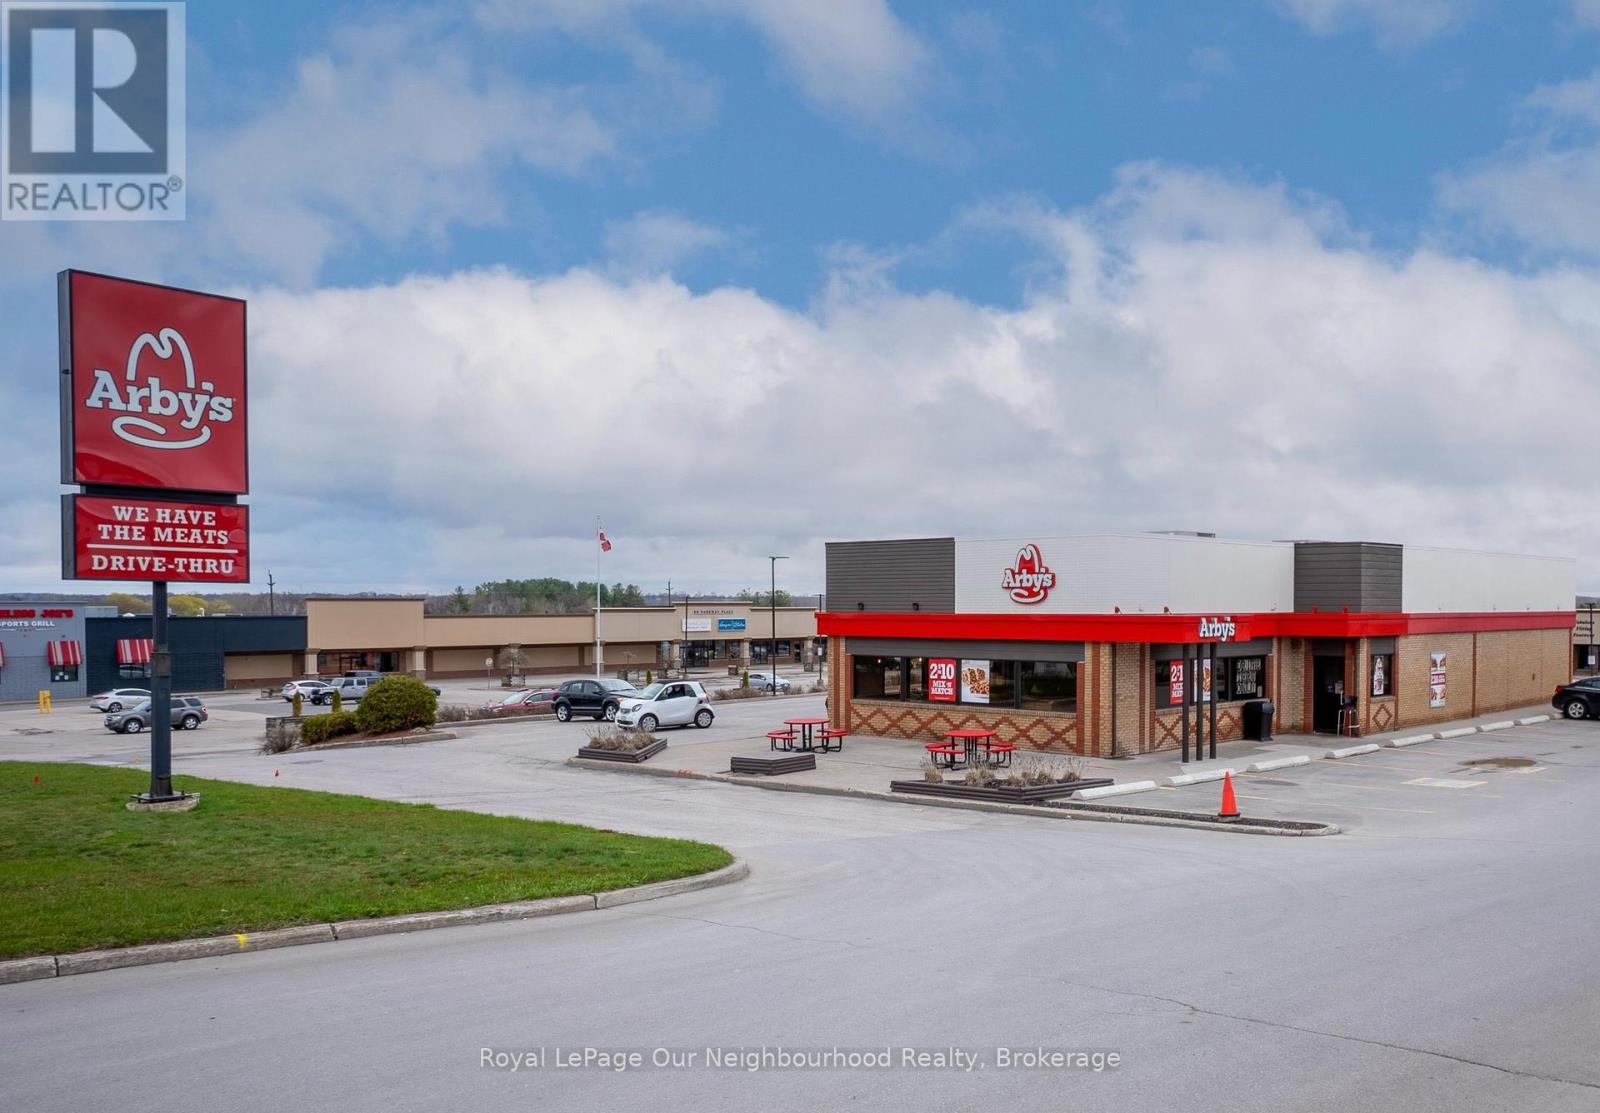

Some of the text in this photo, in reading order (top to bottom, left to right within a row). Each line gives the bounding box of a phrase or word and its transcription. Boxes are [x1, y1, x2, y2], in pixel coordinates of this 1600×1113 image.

[85, 369, 234, 429] Arby's
[112, 505, 216, 526] WE HAVE
[98, 524, 229, 545] THE MEATS
[91, 554, 234, 574] DRIVE-THRU
[1001, 567, 1053, 592] Arby's
[1199, 616, 1236, 642] Arby's
